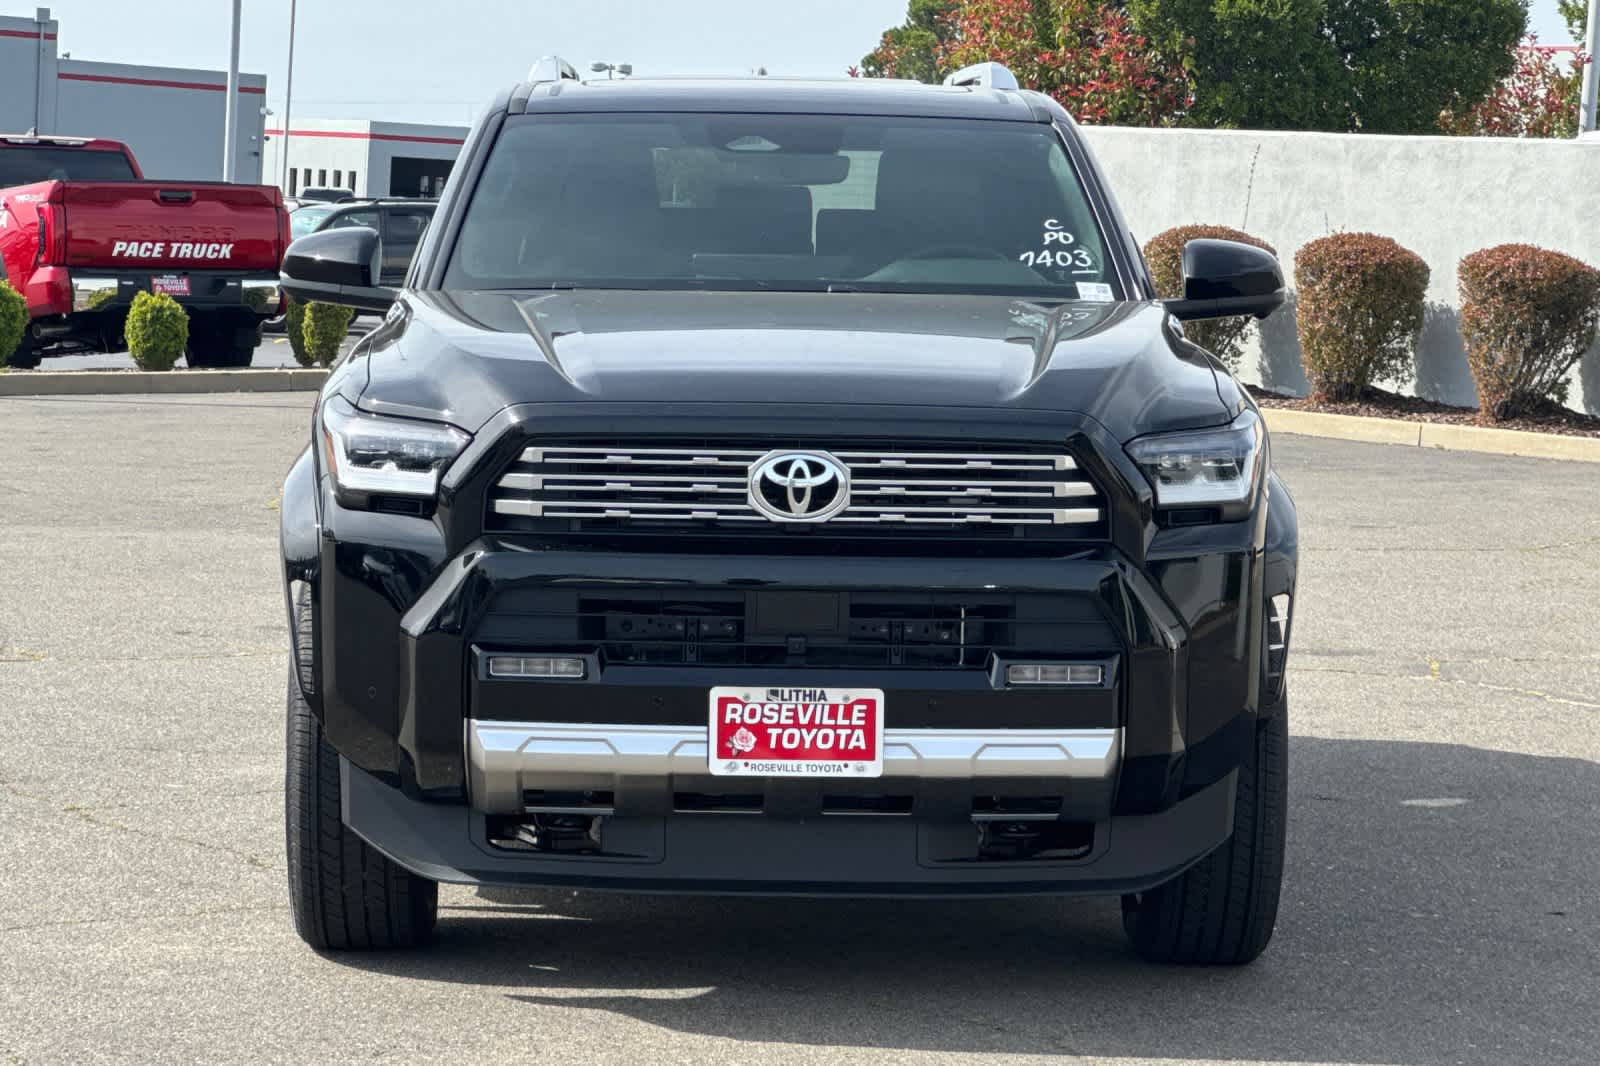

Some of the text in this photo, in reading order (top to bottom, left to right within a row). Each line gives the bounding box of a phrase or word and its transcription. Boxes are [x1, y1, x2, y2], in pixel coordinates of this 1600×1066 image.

[112, 241, 235, 259] PACE TRUCK
[152, 277, 188, 286] ROSEVILLE
[780, 689, 828, 702] LITHIA
[724, 703, 868, 726] ROSEVILLE
[767, 728, 867, 750] TOYOTA
[750, 763, 843, 774] ROSEVILLE TOYOTA
